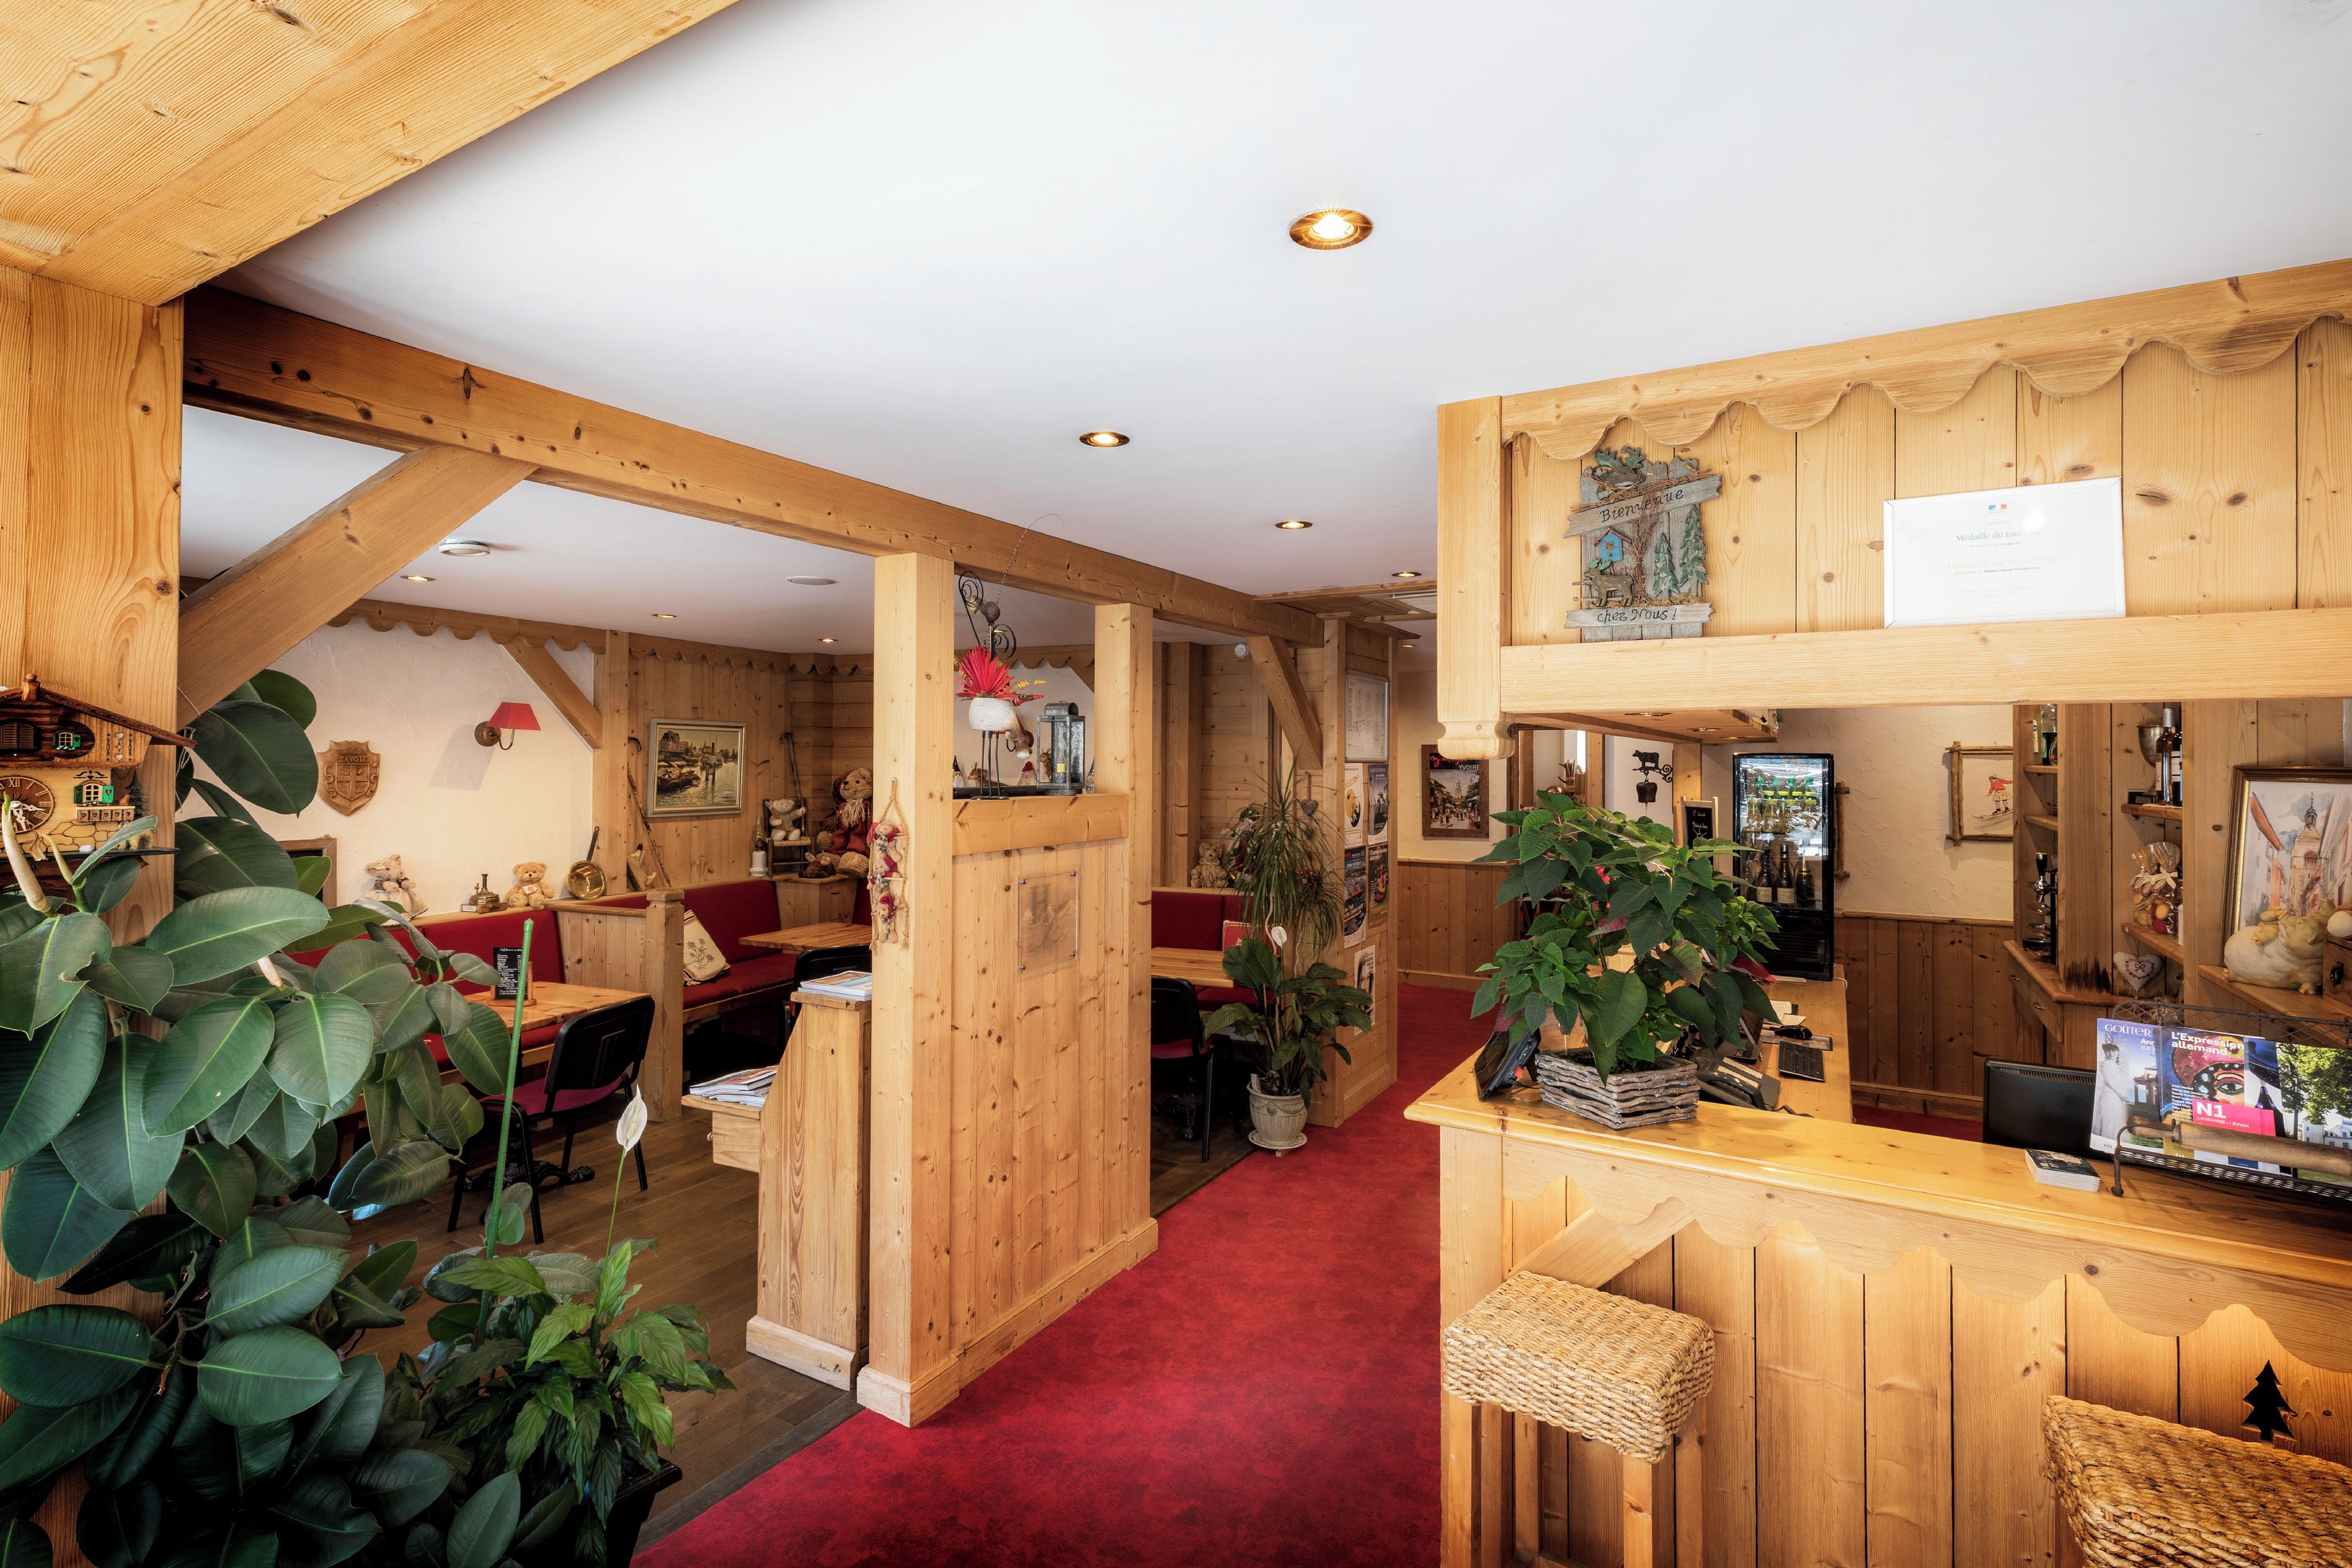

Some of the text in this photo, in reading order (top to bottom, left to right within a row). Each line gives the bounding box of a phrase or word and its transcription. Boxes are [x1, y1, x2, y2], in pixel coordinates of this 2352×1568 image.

[1599, 489, 1684, 523] Bienvenue
[1956, 532, 1991, 542] Médaille
[1992, 530, 2003, 539] du
[1596, 608, 1627, 624] chez
[2171, 1041, 2228, 1056] allemand
[2196, 1101, 2226, 1119] N1
[2197, 1116, 2225, 1125] LAUSANNE
